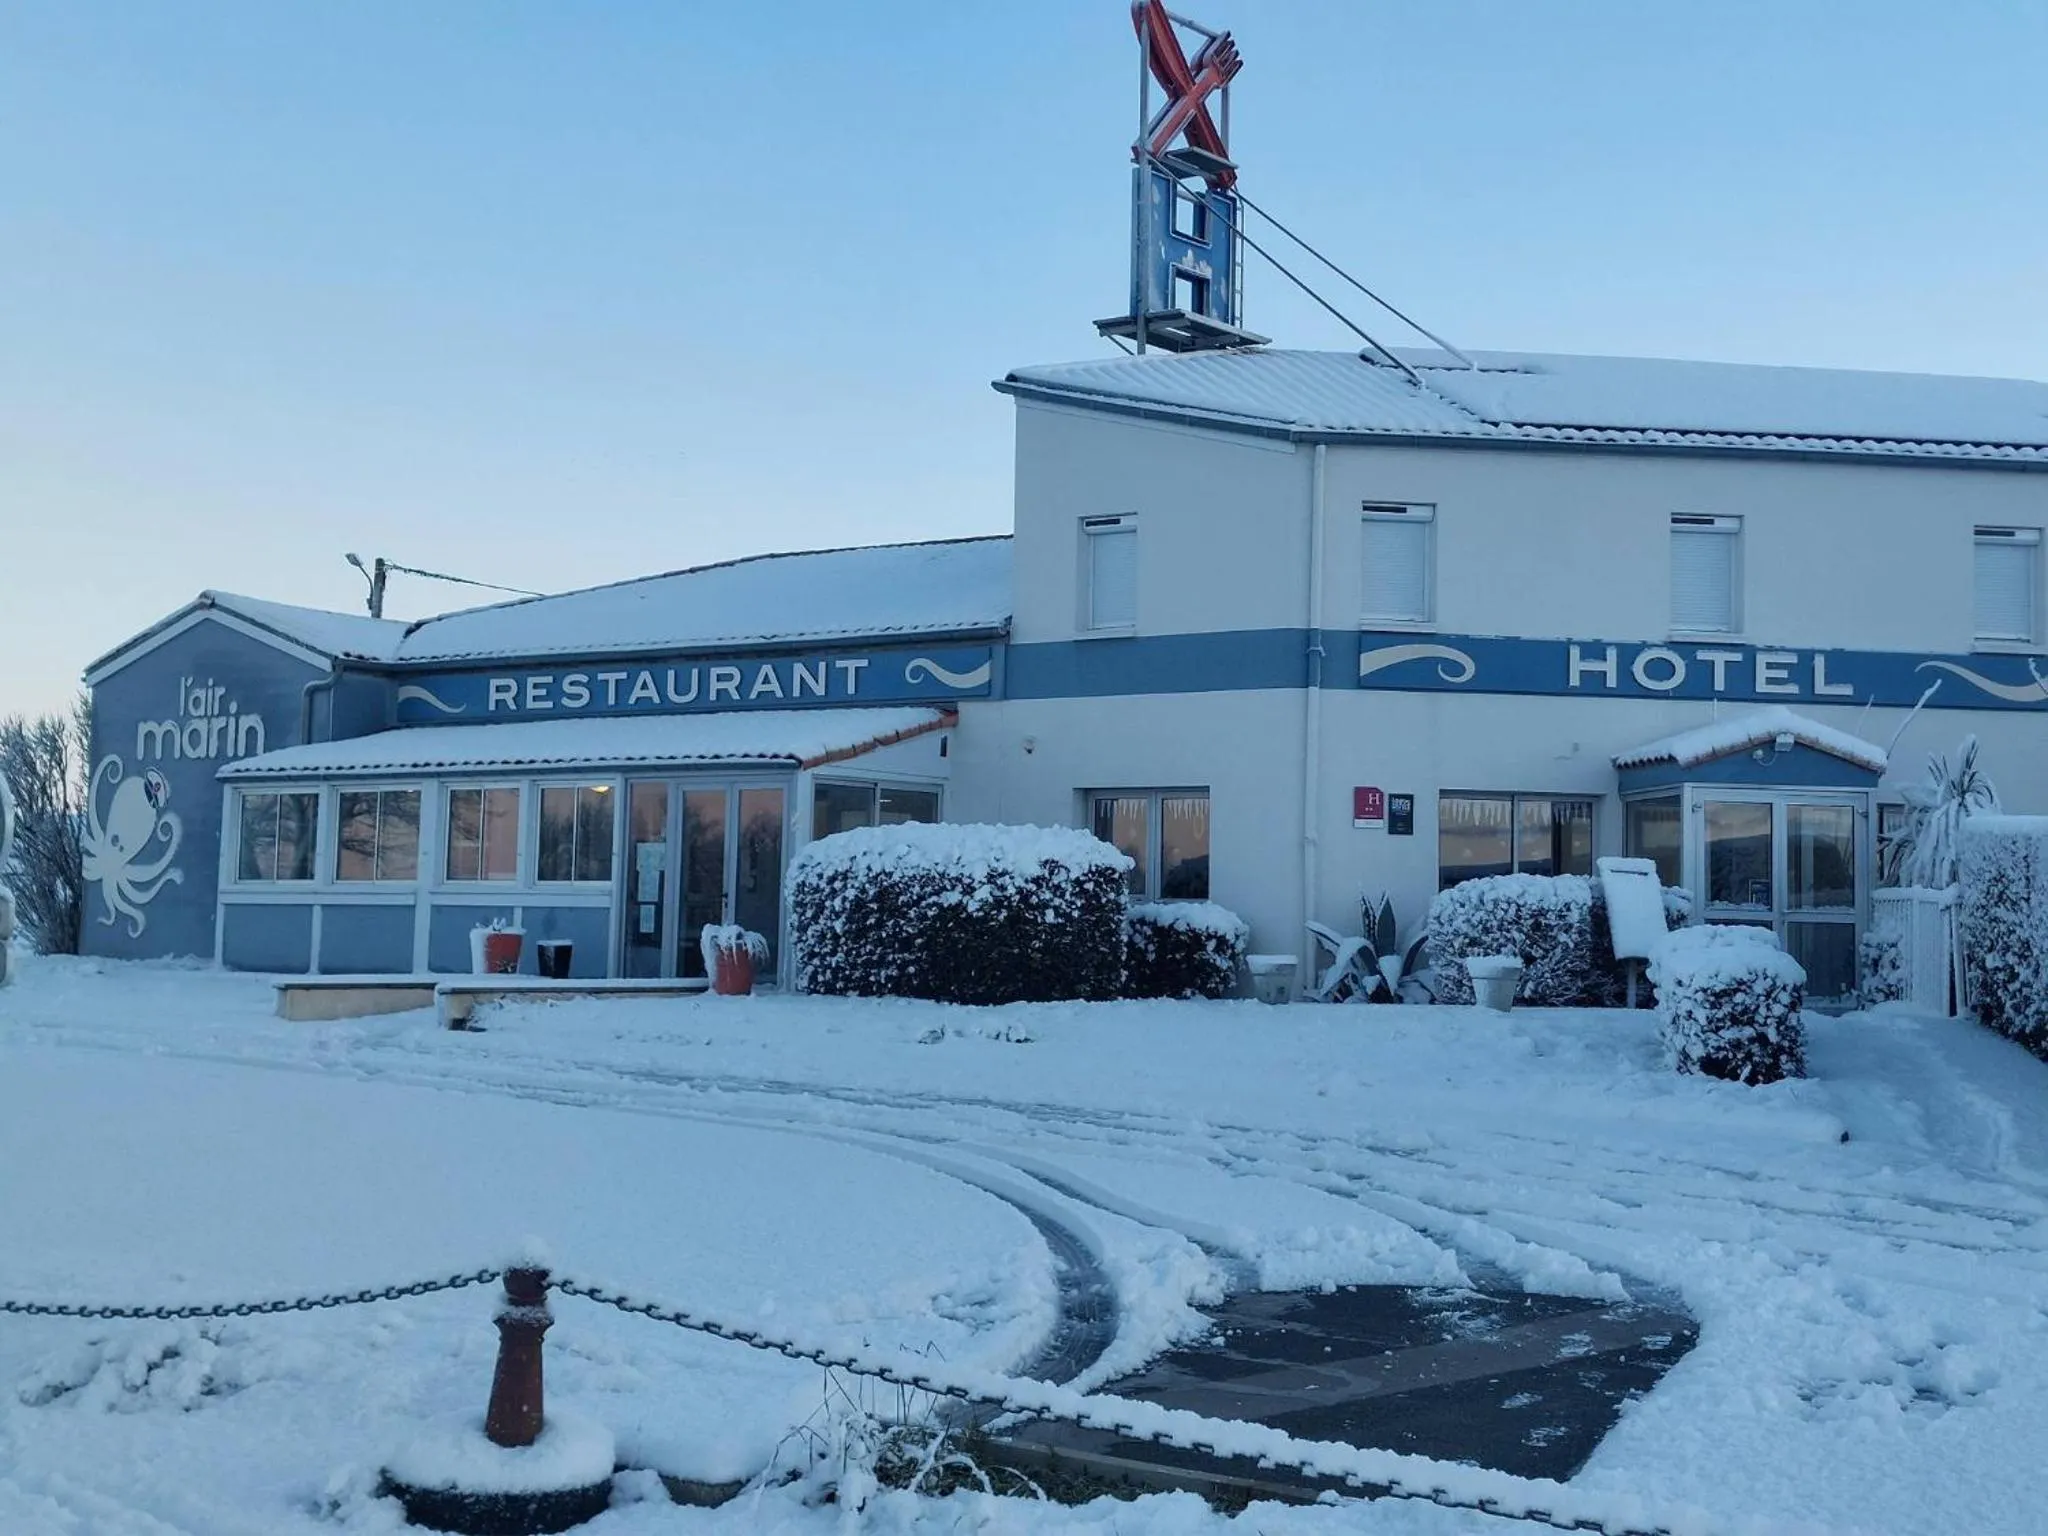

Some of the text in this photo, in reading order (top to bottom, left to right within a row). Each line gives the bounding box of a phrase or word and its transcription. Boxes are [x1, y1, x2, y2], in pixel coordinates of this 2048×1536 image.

[179, 676, 226, 716] l'air
[487, 658, 869, 711] RESTAURANT
[1568, 644, 1854, 696] HOTEL
[136, 700, 265, 761] marin
[1368, 792, 1380, 805] H
